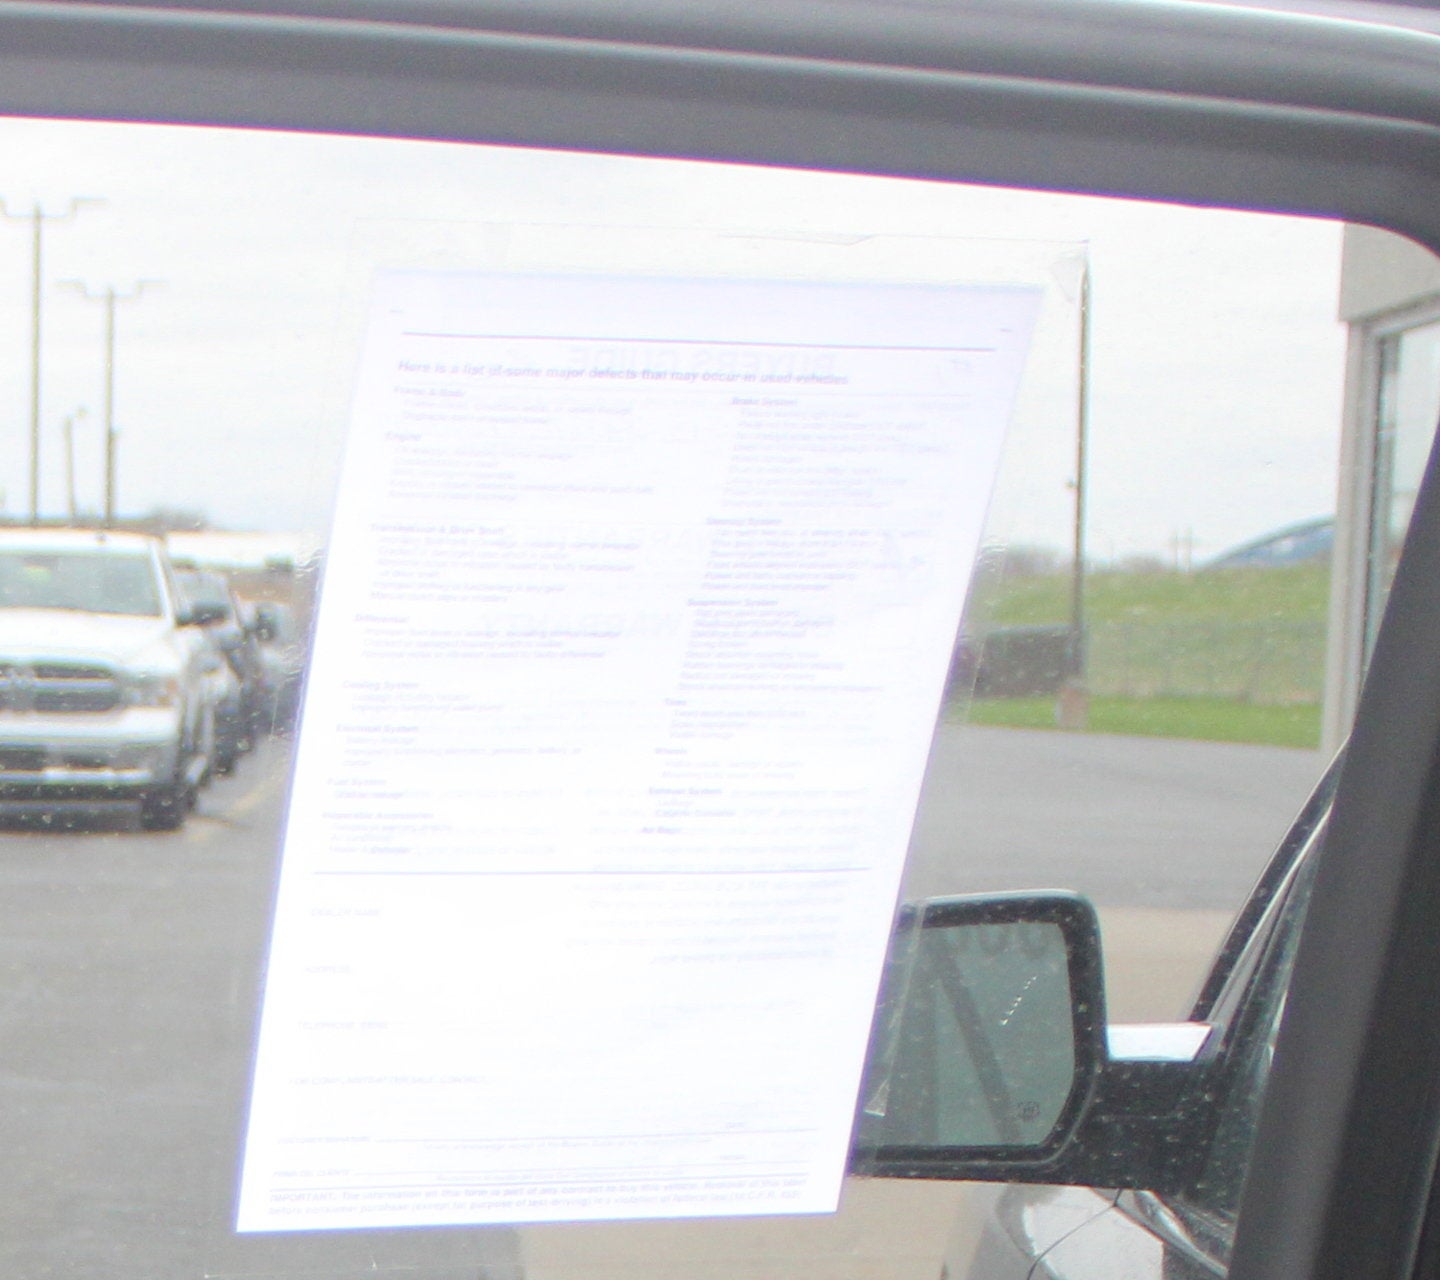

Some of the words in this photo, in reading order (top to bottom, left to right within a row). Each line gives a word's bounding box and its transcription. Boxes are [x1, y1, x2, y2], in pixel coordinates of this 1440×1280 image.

[397, 359, 430, 373] Here
[435, 362, 446, 374] is
[450, 366, 458, 374] a
[463, 362, 484, 376] list
[546, 367, 584, 381] major
[589, 366, 637, 379] defects
[642, 368, 667, 380] that
[670, 370, 699, 384] may
[702, 372, 739, 382] occur
[760, 372, 792, 383] used
